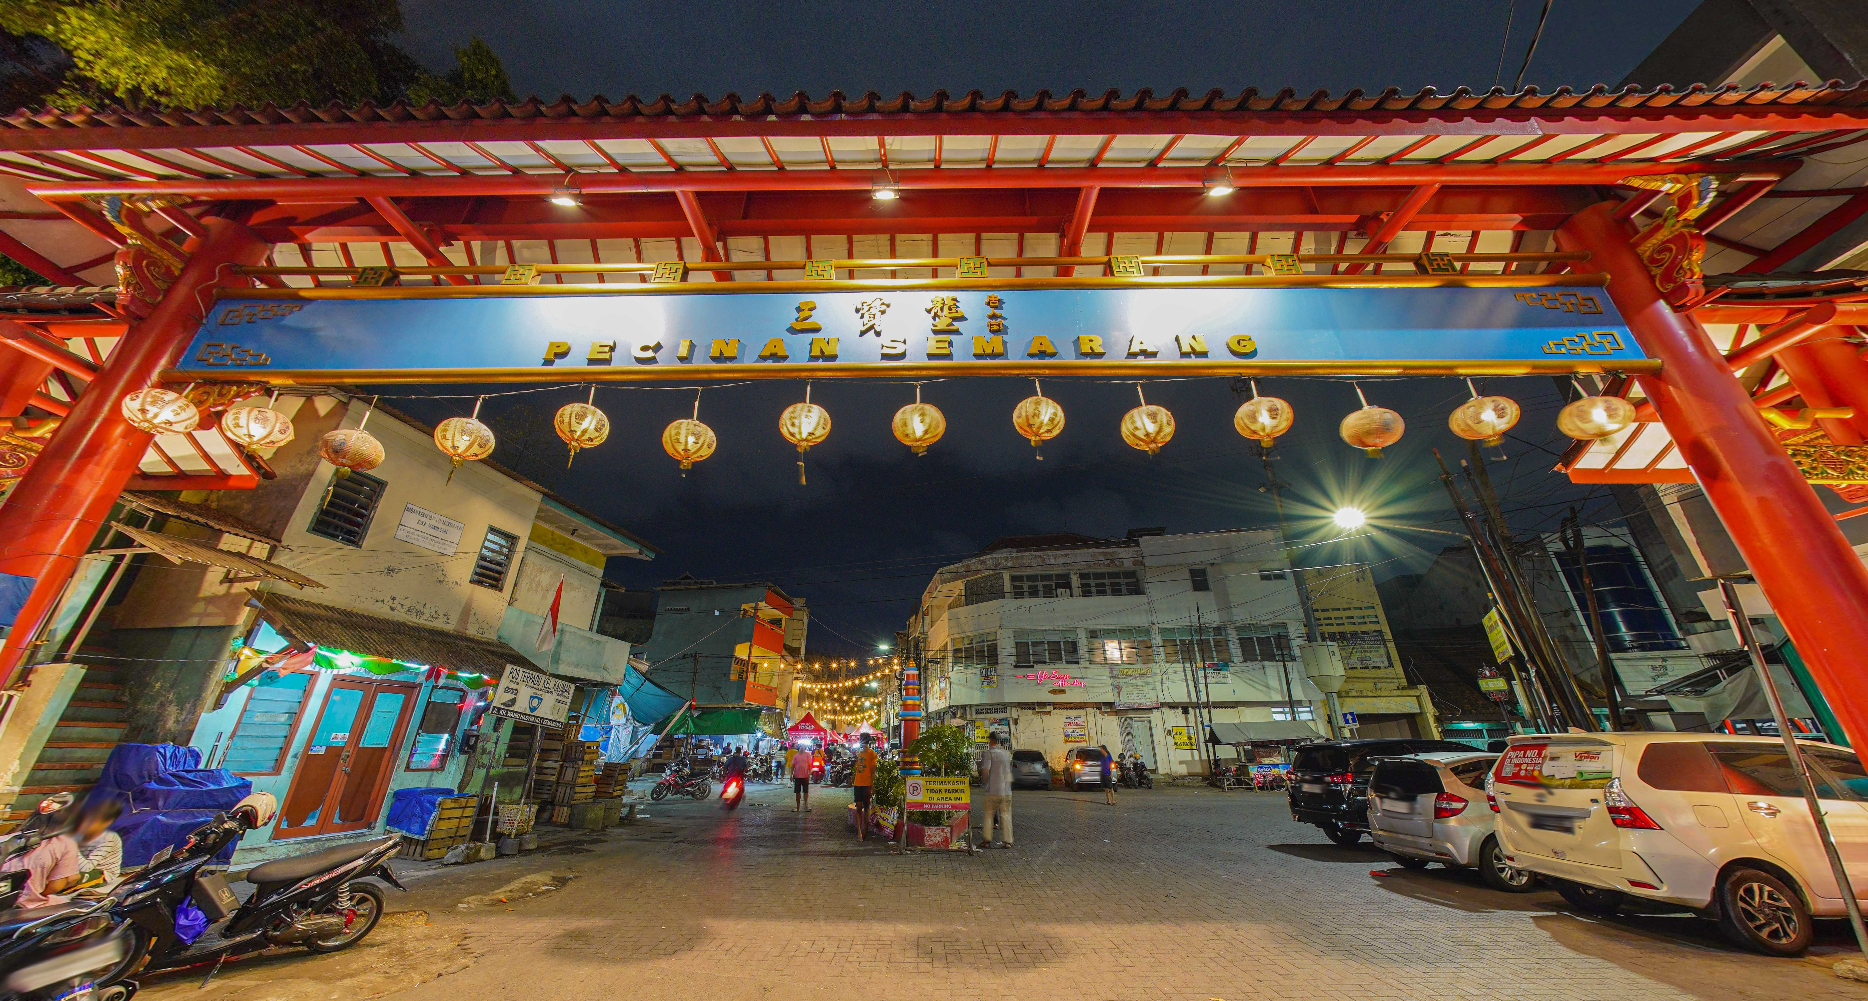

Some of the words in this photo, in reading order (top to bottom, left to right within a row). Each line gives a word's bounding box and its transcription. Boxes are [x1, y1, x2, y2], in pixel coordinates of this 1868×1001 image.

[543, 337, 840, 361] PECINAN
[880, 334, 1257, 357] SEMARANG
[1506, 750, 1524, 759] PIPA
[1525, 749, 1539, 758] NO.
[1541, 749, 1547, 758] 1
